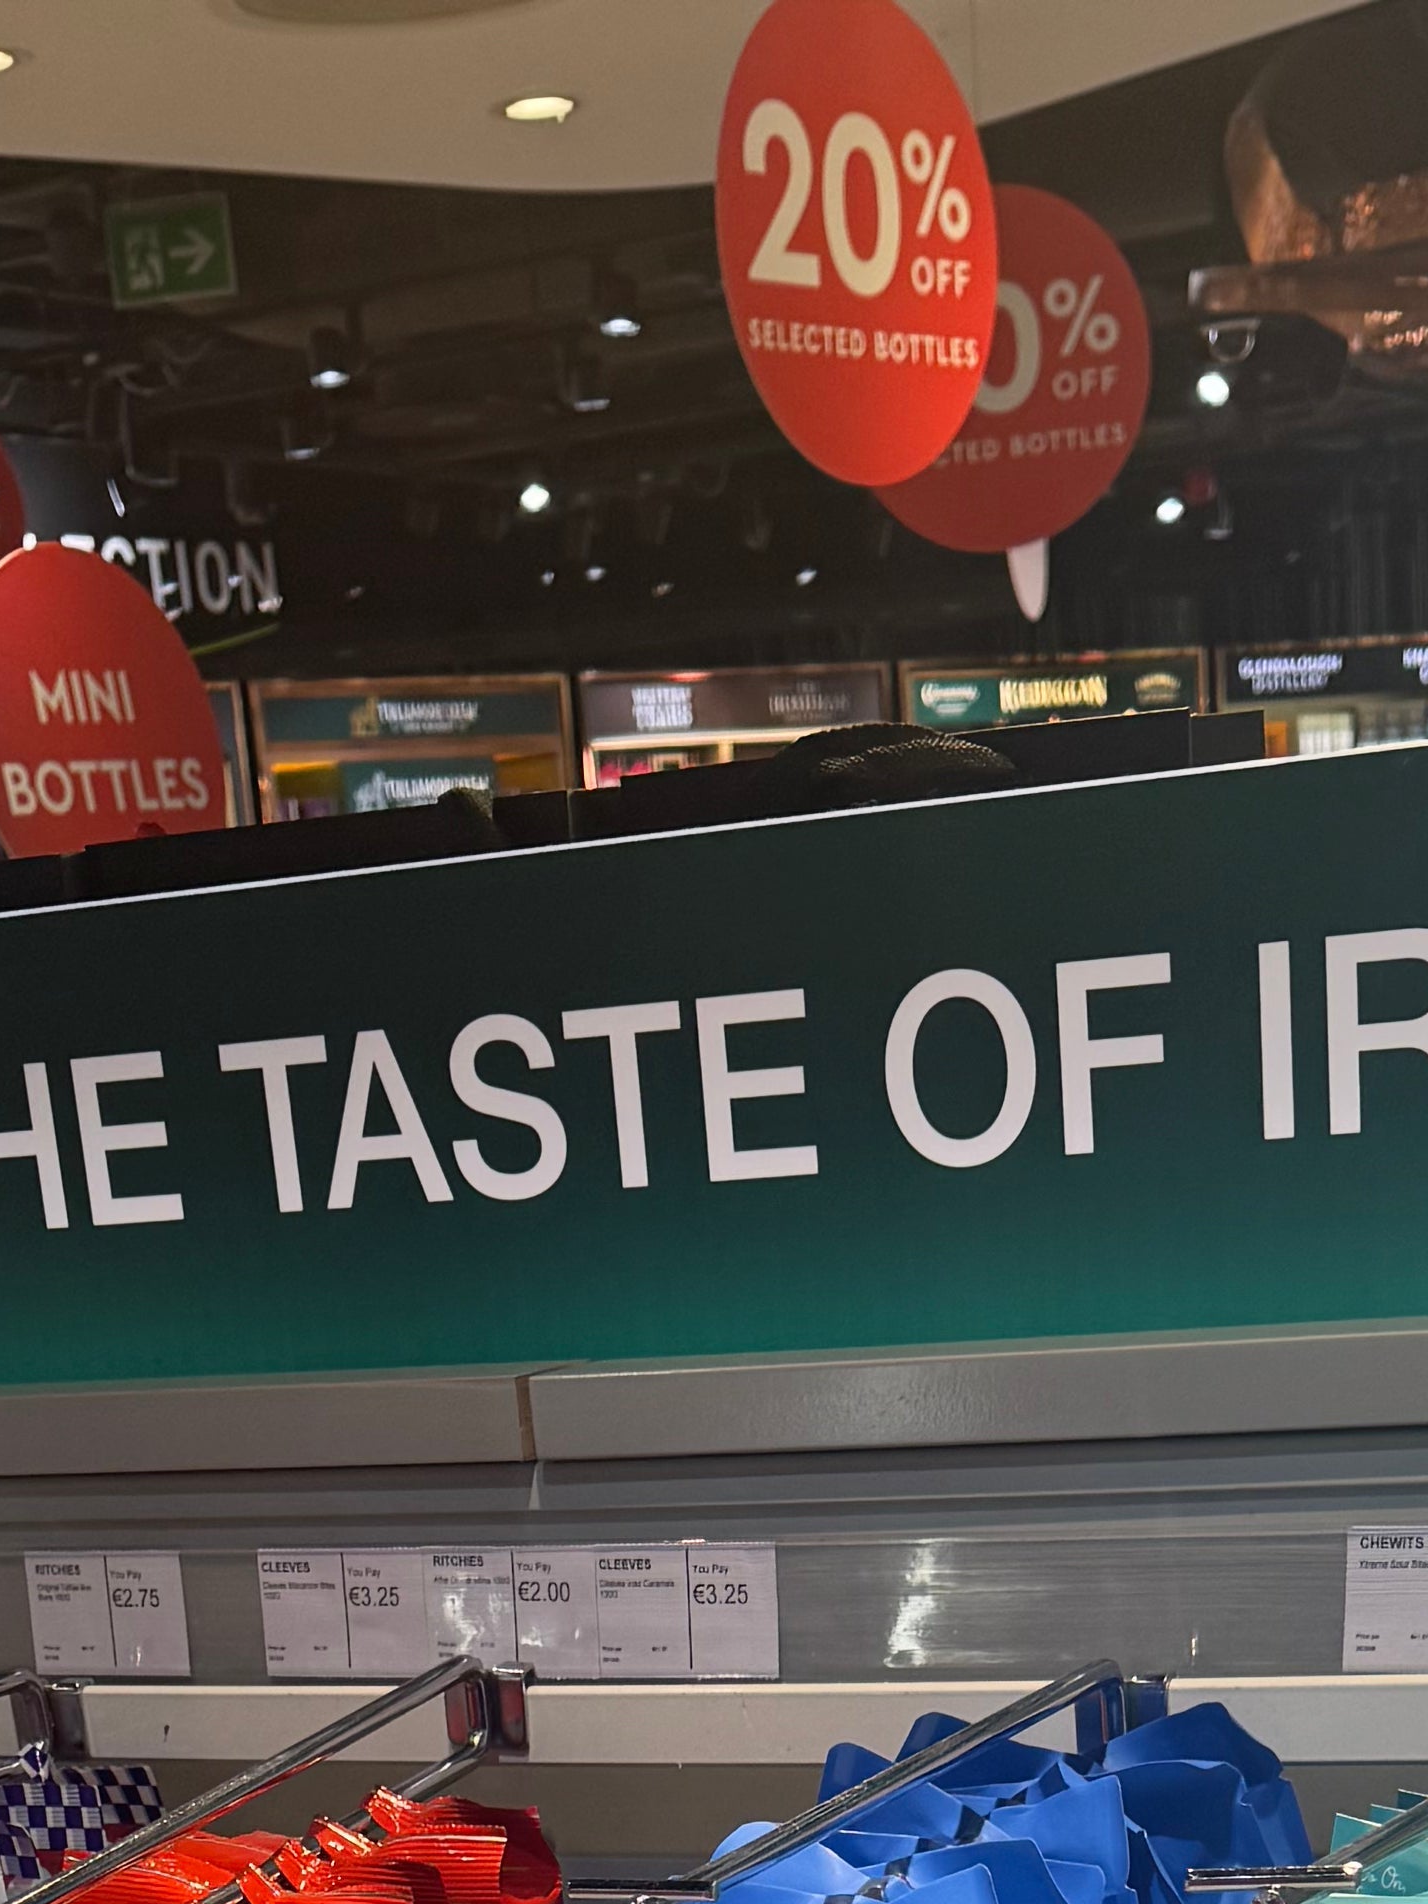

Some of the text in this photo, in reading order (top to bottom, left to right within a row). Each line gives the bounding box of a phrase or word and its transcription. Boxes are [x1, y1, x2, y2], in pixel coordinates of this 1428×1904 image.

[742, 98, 970, 296] 20%
[911, 257, 970, 297] OFF
[747, 317, 979, 369] SELECTED BOTTLES
[976, 273, 1119, 411] 0%
[1053, 363, 1117, 398] OFF
[1010, 422, 1127, 464] BOTTLES
[29, 670, 135, 725] MINI
[2, 760, 208, 816] BOTTLES
[219, 989, 817, 1214] TASTE
[884, 951, 1173, 1170] OF
[1360, 1535, 1425, 1551] CHEWITS
[35, 1564, 81, 1576] RITCHIES
[261, 1561, 310, 1573] CLEEVES
[433, 1555, 484, 1567] RITCHIES
[599, 1559, 652, 1570] CLEEVES
[693, 1564, 729, 1576] You Pay
[347, 1567, 380, 1579] You Pay
[113, 1588, 160, 1608] €2.75
[349, 1586, 399, 1607] €3.25
[518, 1581, 570, 1602] €2.00
[693, 1583, 748, 1605] €3.25
